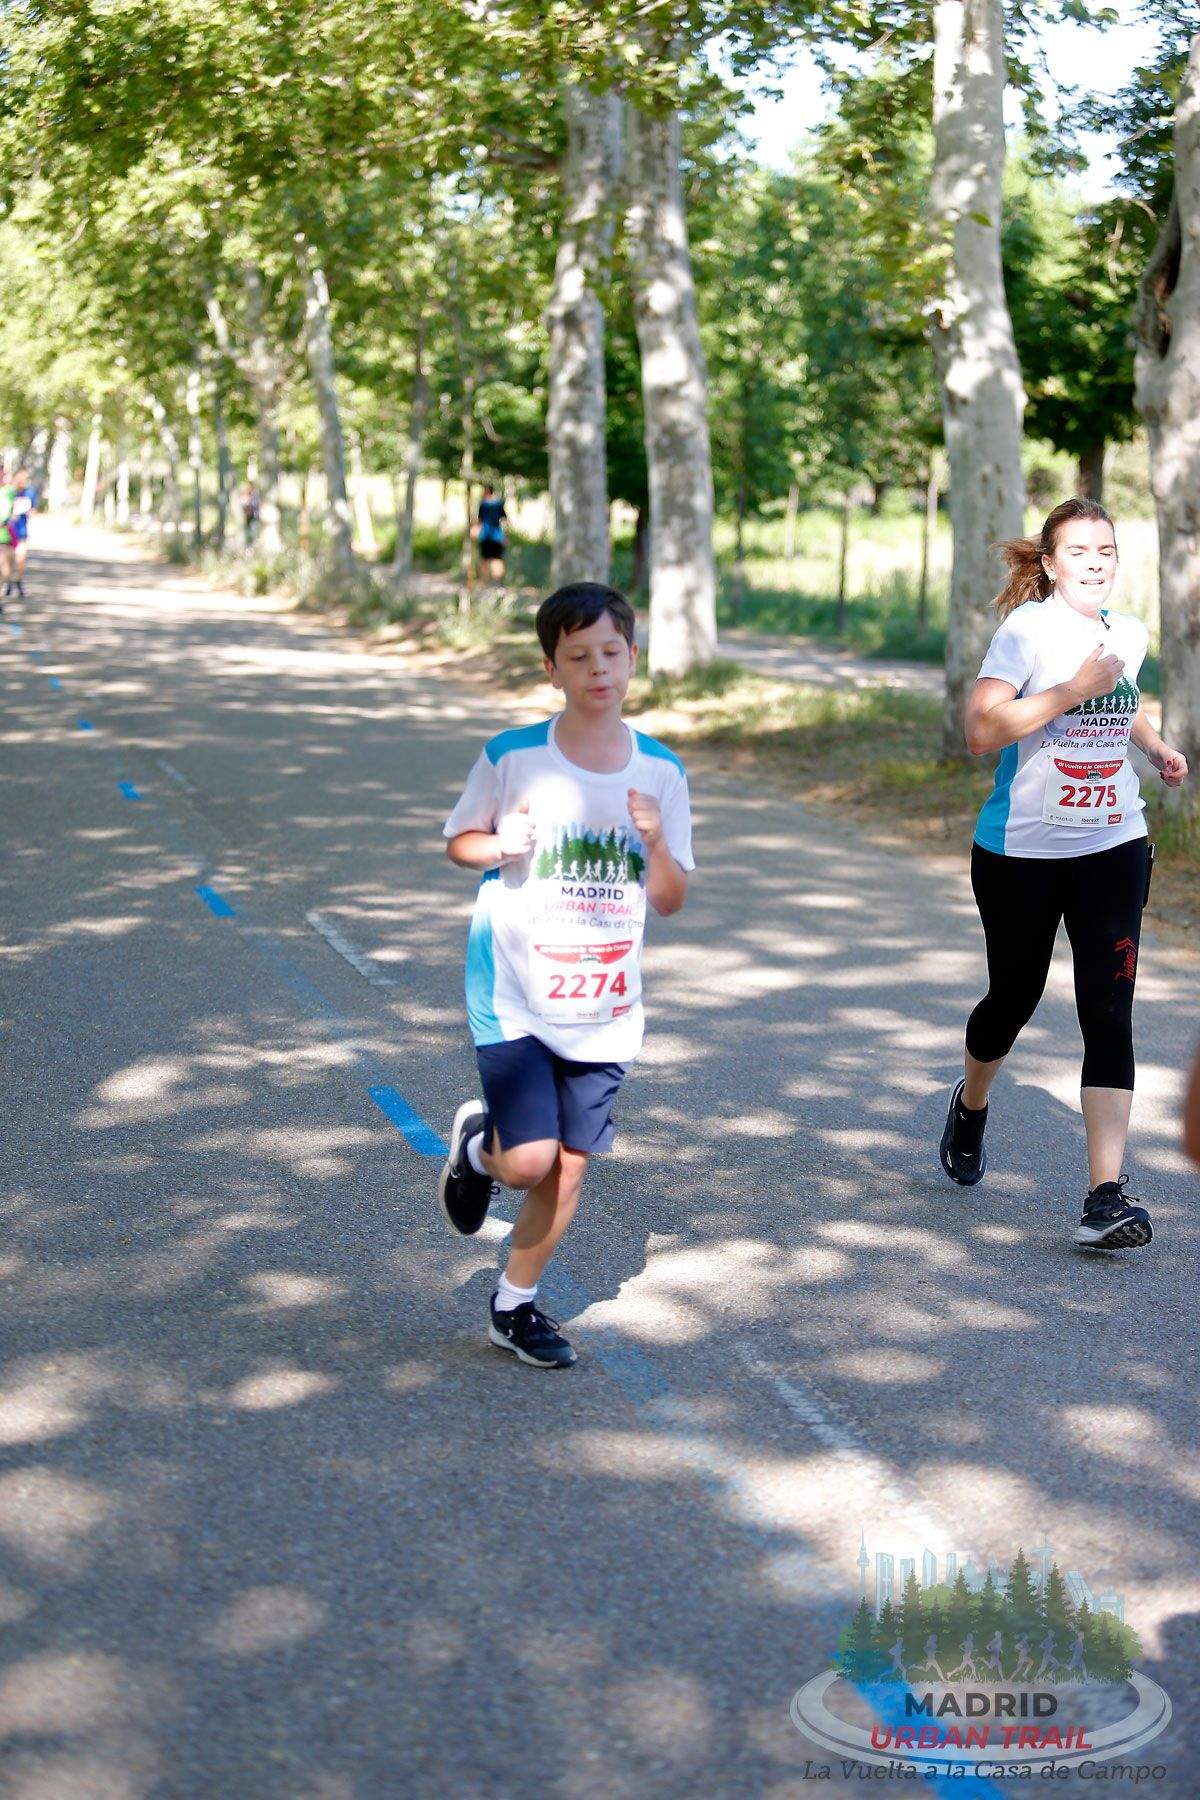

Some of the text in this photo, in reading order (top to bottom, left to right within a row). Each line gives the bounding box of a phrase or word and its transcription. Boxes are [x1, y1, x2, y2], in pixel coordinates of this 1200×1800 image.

[1080, 717, 1129, 727] MADRID
[1065, 728, 1129, 738] URBAN TRAI
[1053, 738, 1079, 748] Vuelta
[1096, 740, 1115, 748] Casa
[1058, 784, 1117, 808] 2275
[561, 886, 624, 900] MADRID
[548, 971, 628, 999] 2274
